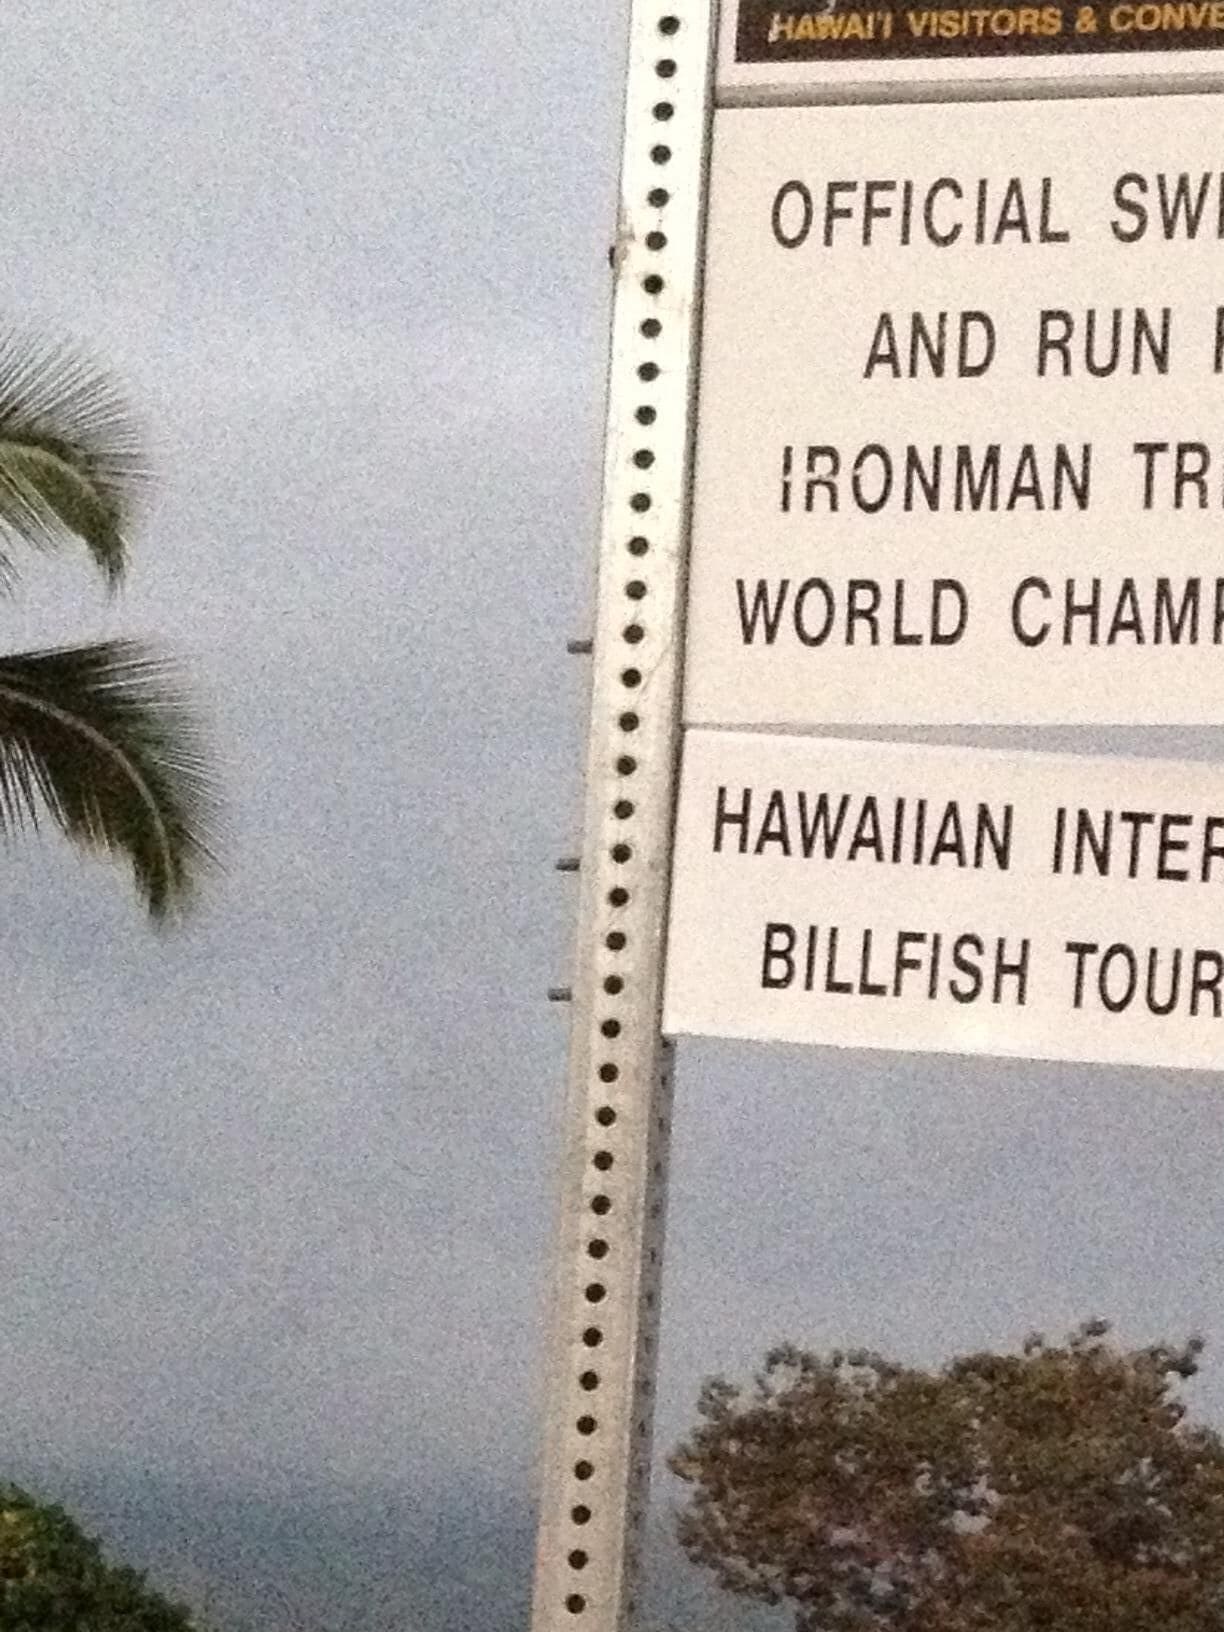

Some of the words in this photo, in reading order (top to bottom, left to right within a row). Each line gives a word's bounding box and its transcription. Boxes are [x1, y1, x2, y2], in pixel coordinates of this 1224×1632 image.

[907, 6, 1062, 38] VISITORS
[1075, 6, 1097, 33] &
[772, 177, 1070, 249] OFFICIAL
[863, 311, 995, 378] AND
[1037, 308, 1171, 377] RUN
[781, 444, 1091, 514] IRONMAN
[736, 577, 968, 647] WORLD
[712, 786, 1013, 870] HAWAIIAN
[761, 922, 1030, 1005] BILLFISH
